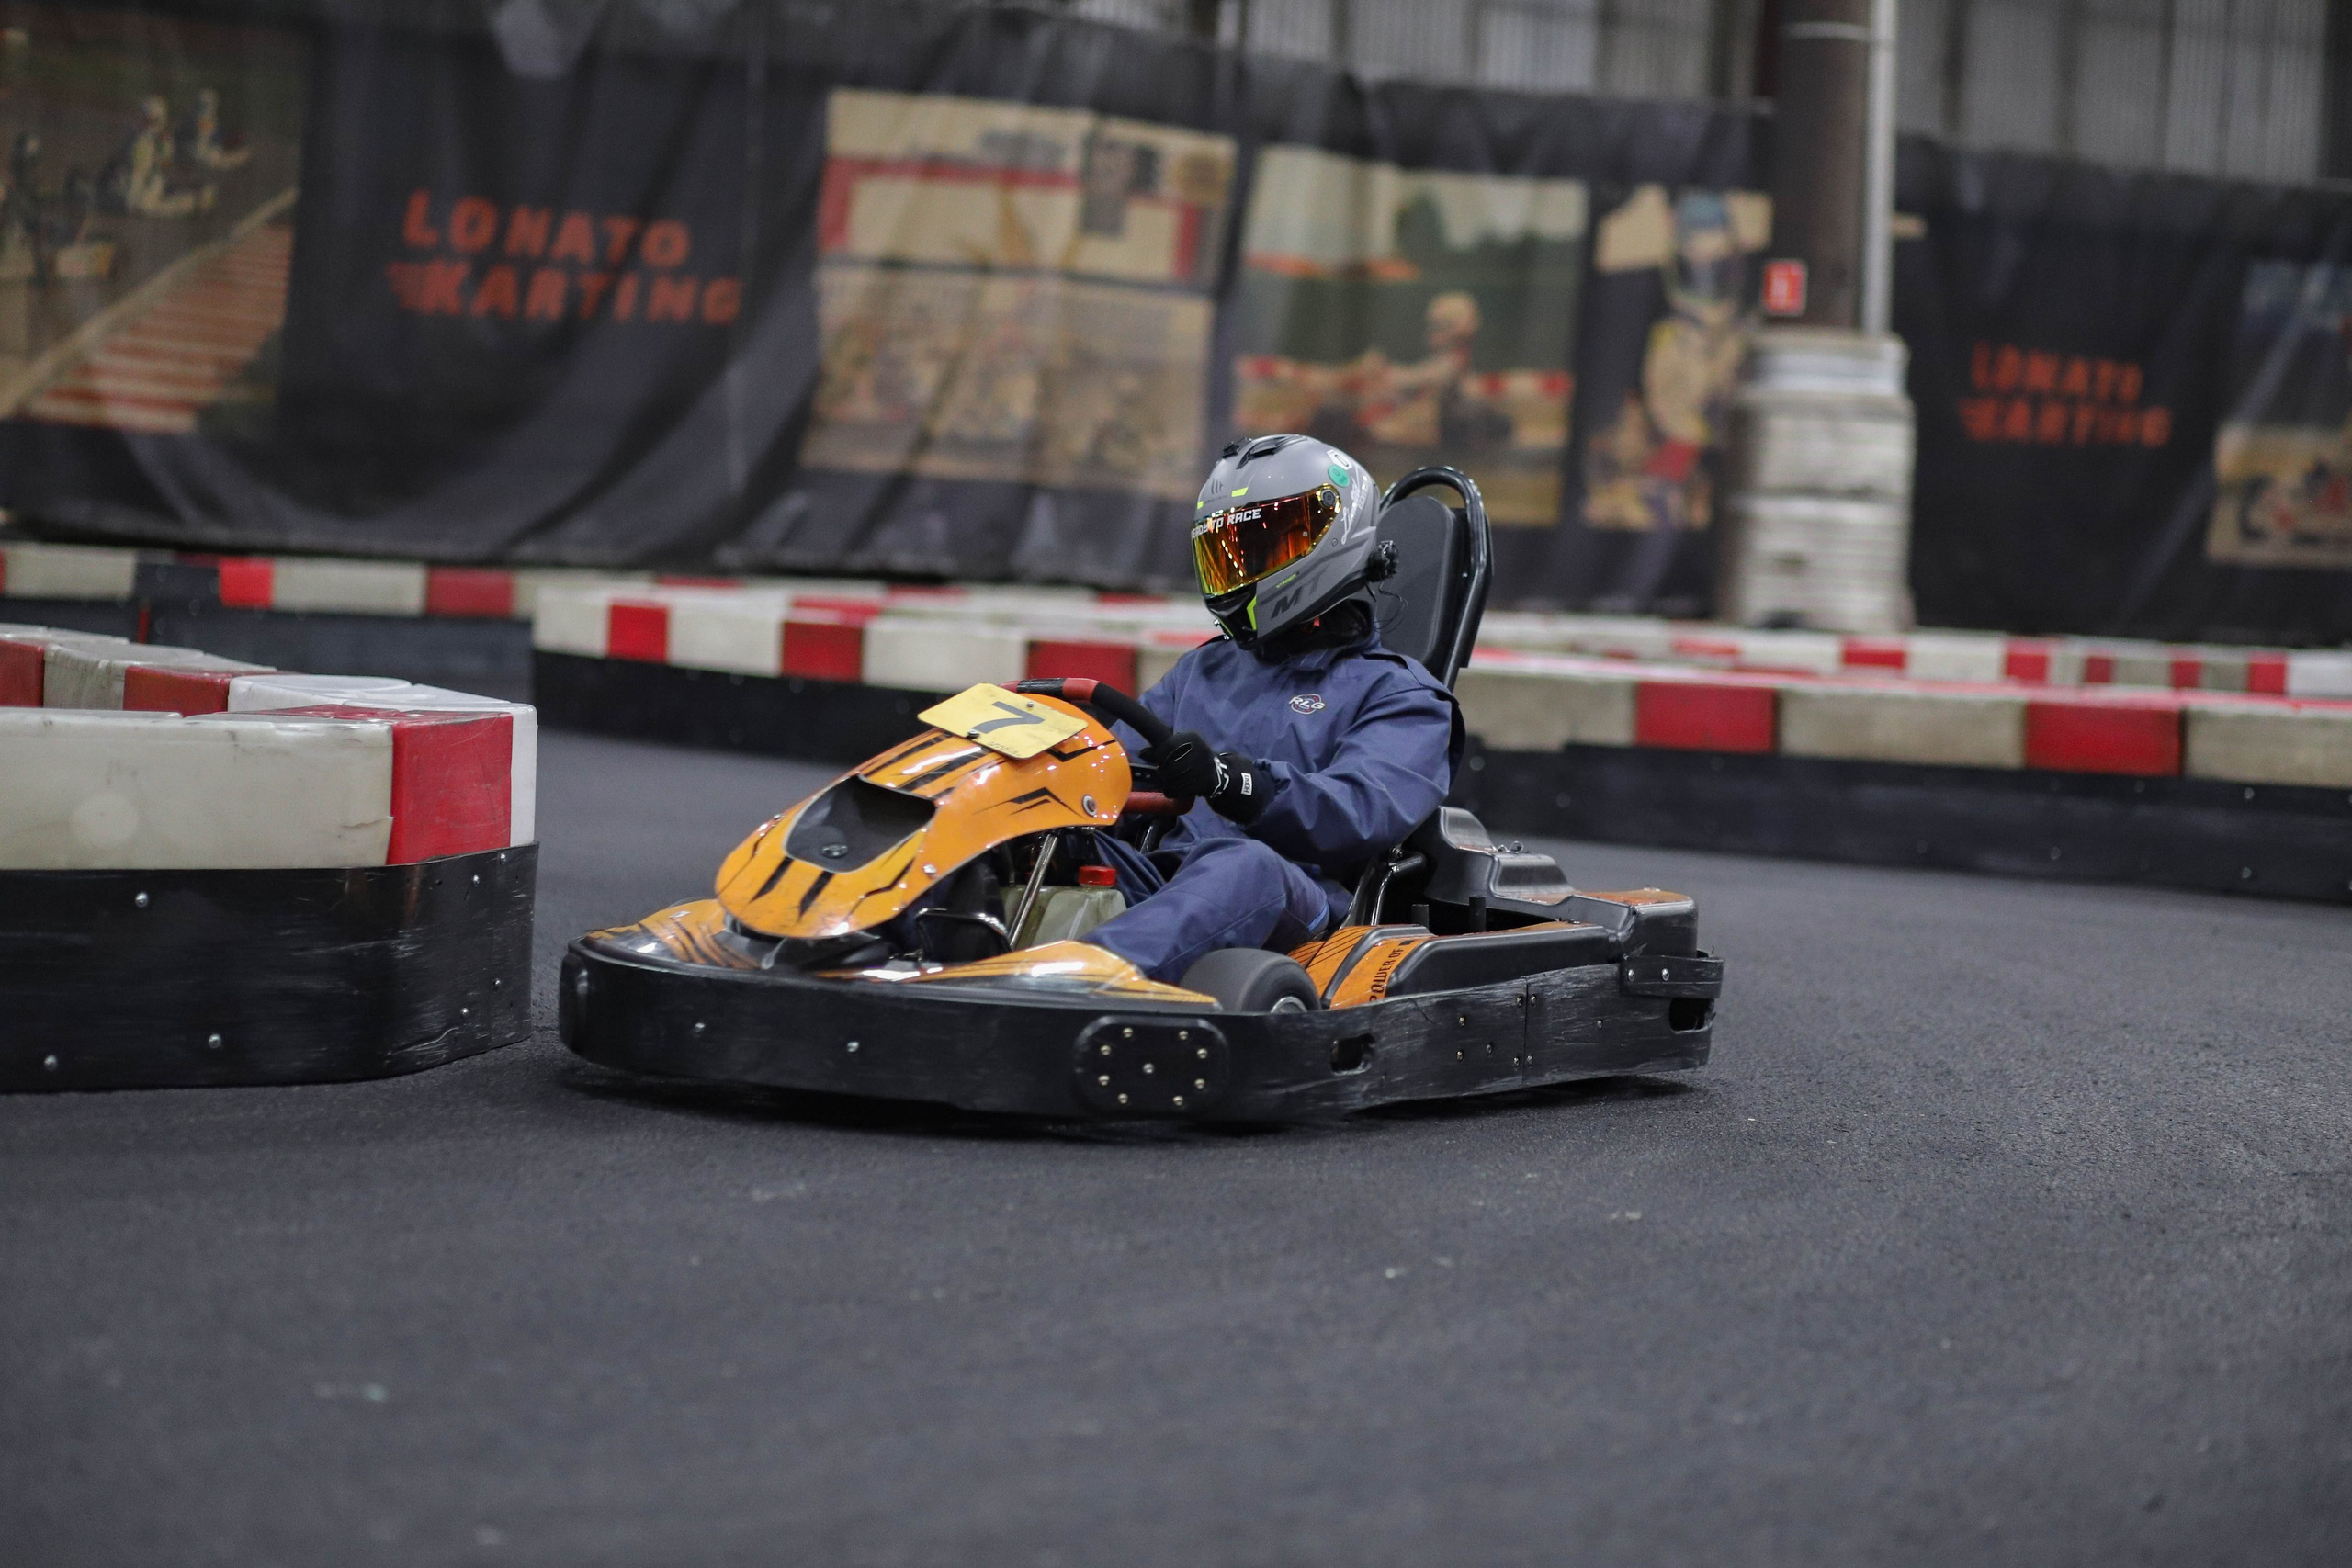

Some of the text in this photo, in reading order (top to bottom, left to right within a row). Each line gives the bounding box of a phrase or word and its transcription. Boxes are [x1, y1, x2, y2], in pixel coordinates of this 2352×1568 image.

[402, 188, 692, 270] LONATO
[390, 260, 741, 325] KARTING
[1971, 341, 2143, 404] LONATO
[1191, 508, 1262, 539] EADY TO RACE
[971, 701, 1046, 734] 7
[1289, 696, 1325, 709] RLG
[1388, 948, 1404, 958] OF
